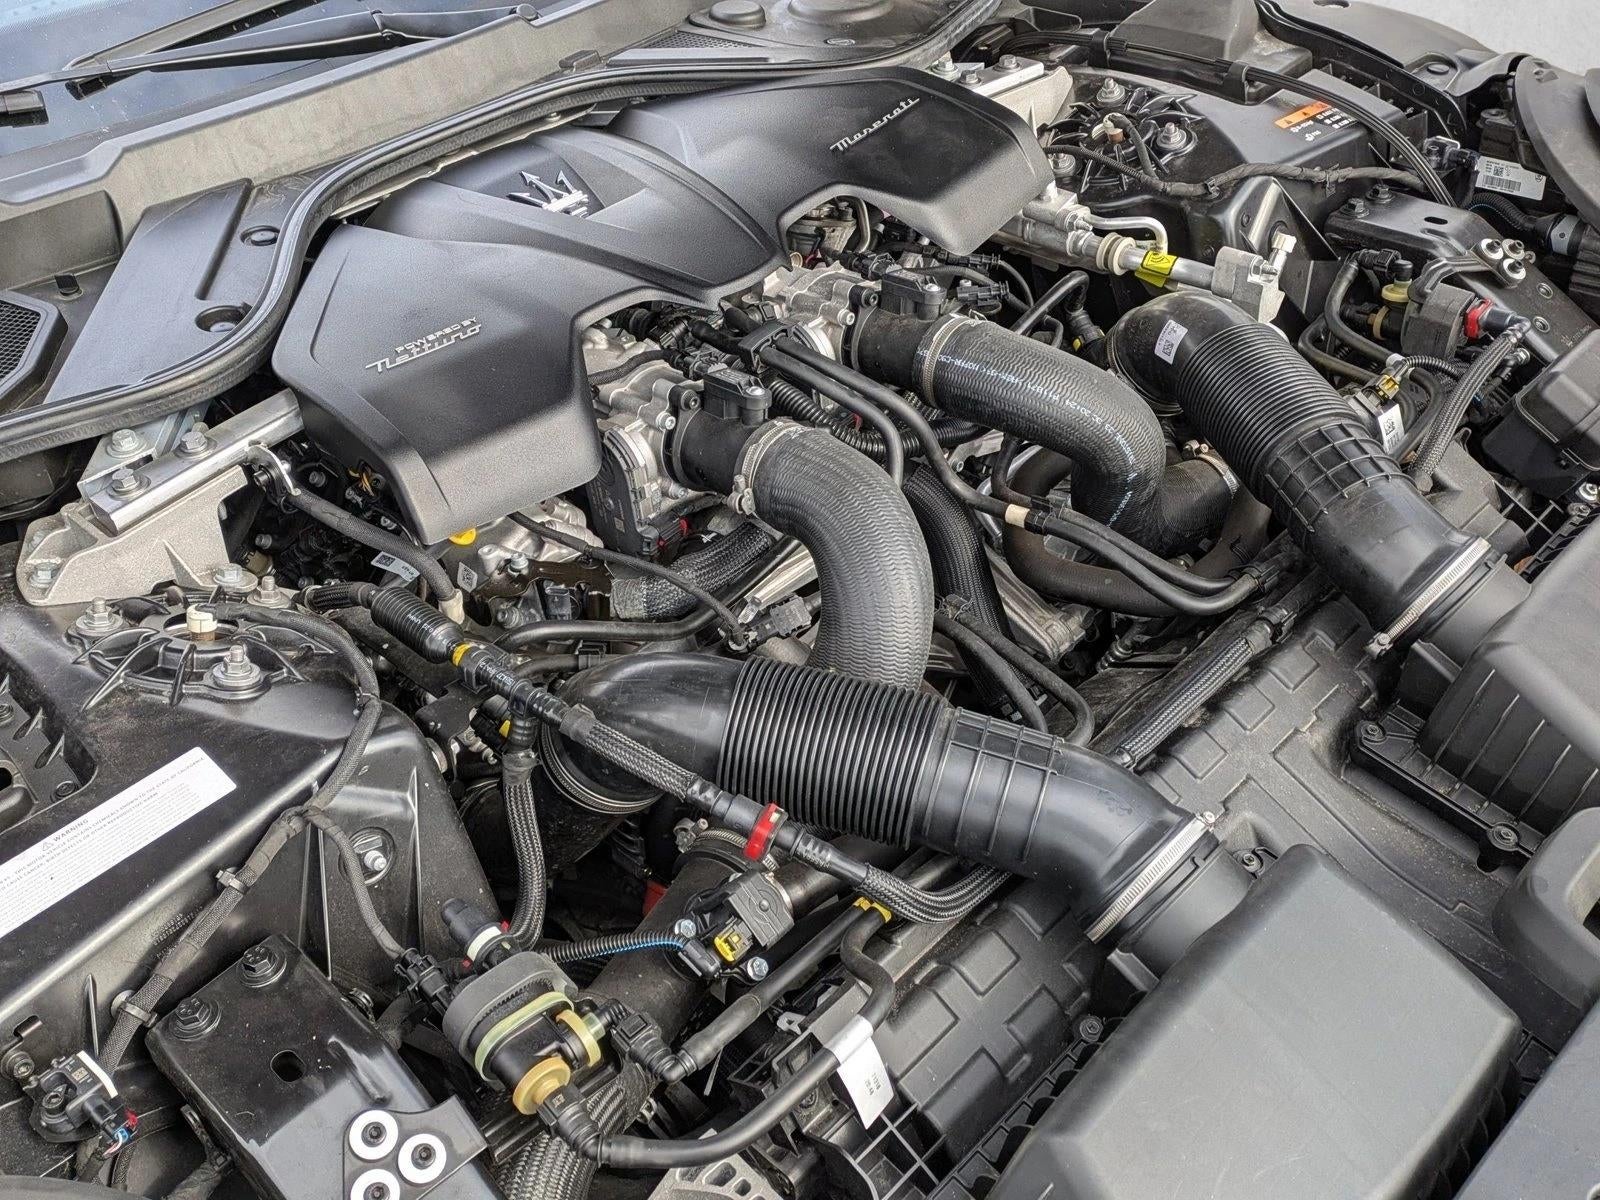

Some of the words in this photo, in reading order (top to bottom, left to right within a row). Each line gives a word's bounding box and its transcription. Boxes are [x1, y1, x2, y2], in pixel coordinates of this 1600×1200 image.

[829, 98, 920, 152] Maserati
[365, 324, 482, 373] Nettuno
[53, 818, 88, 842] WARNING
